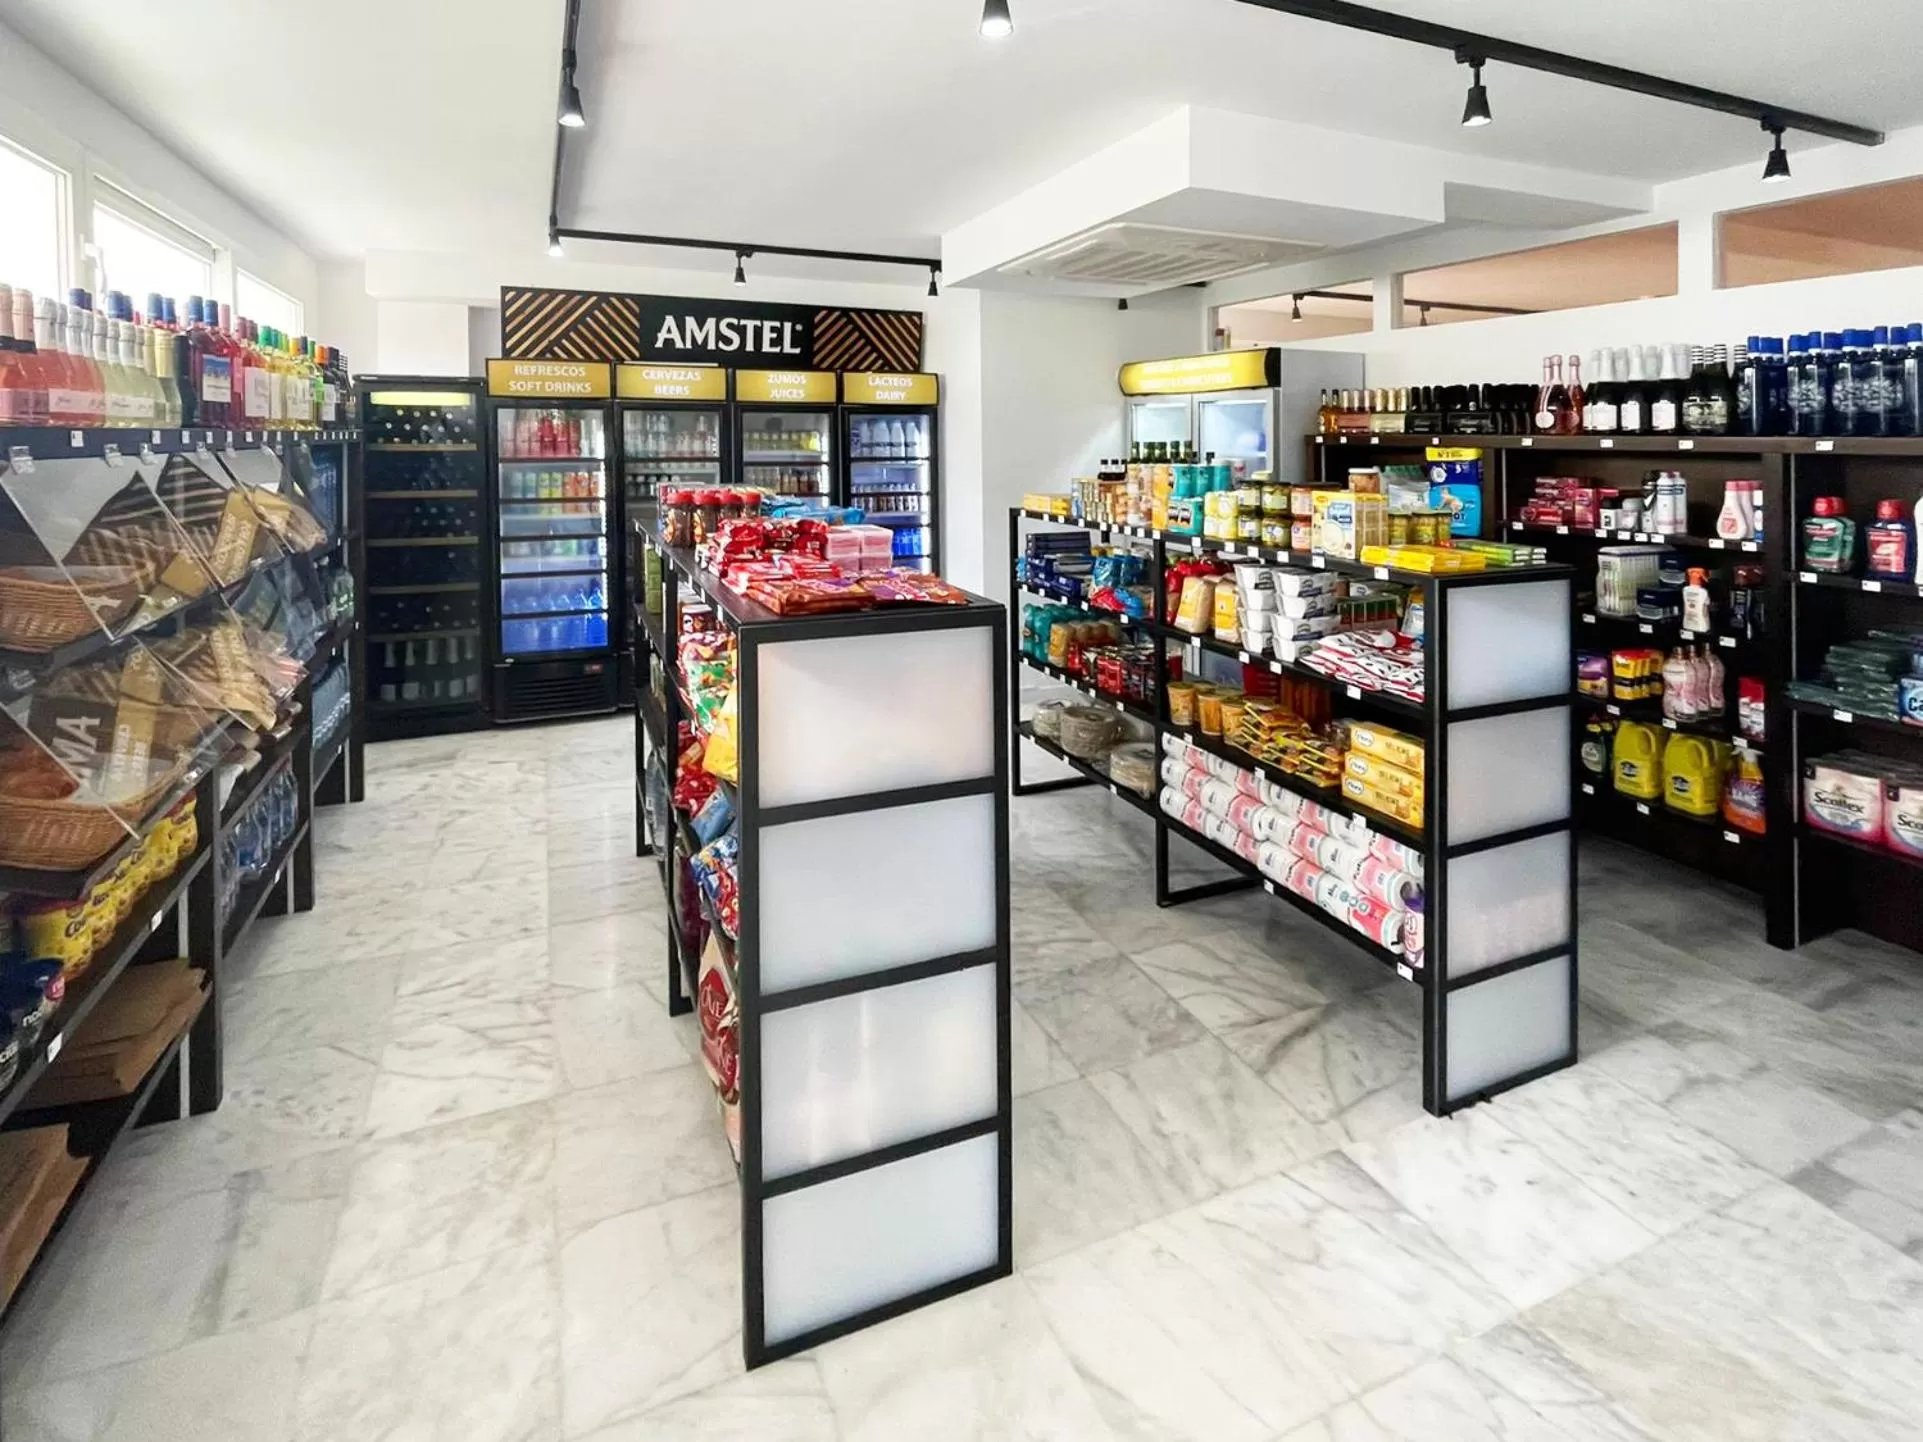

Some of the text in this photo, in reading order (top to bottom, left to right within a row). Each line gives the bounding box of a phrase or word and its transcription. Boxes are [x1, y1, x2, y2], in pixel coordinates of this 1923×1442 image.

[654, 314, 802, 354] AMSTEL
[514, 364, 587, 377] REFRESCOS
[642, 368, 702, 381] CERVEZAS
[767, 373, 807, 384] ZUMOS
[508, 380, 593, 394] SOFT DRINKS
[654, 384, 691, 396] BEERS
[769, 388, 805, 400] JUICES
[875, 390, 906, 401] DAIRY
